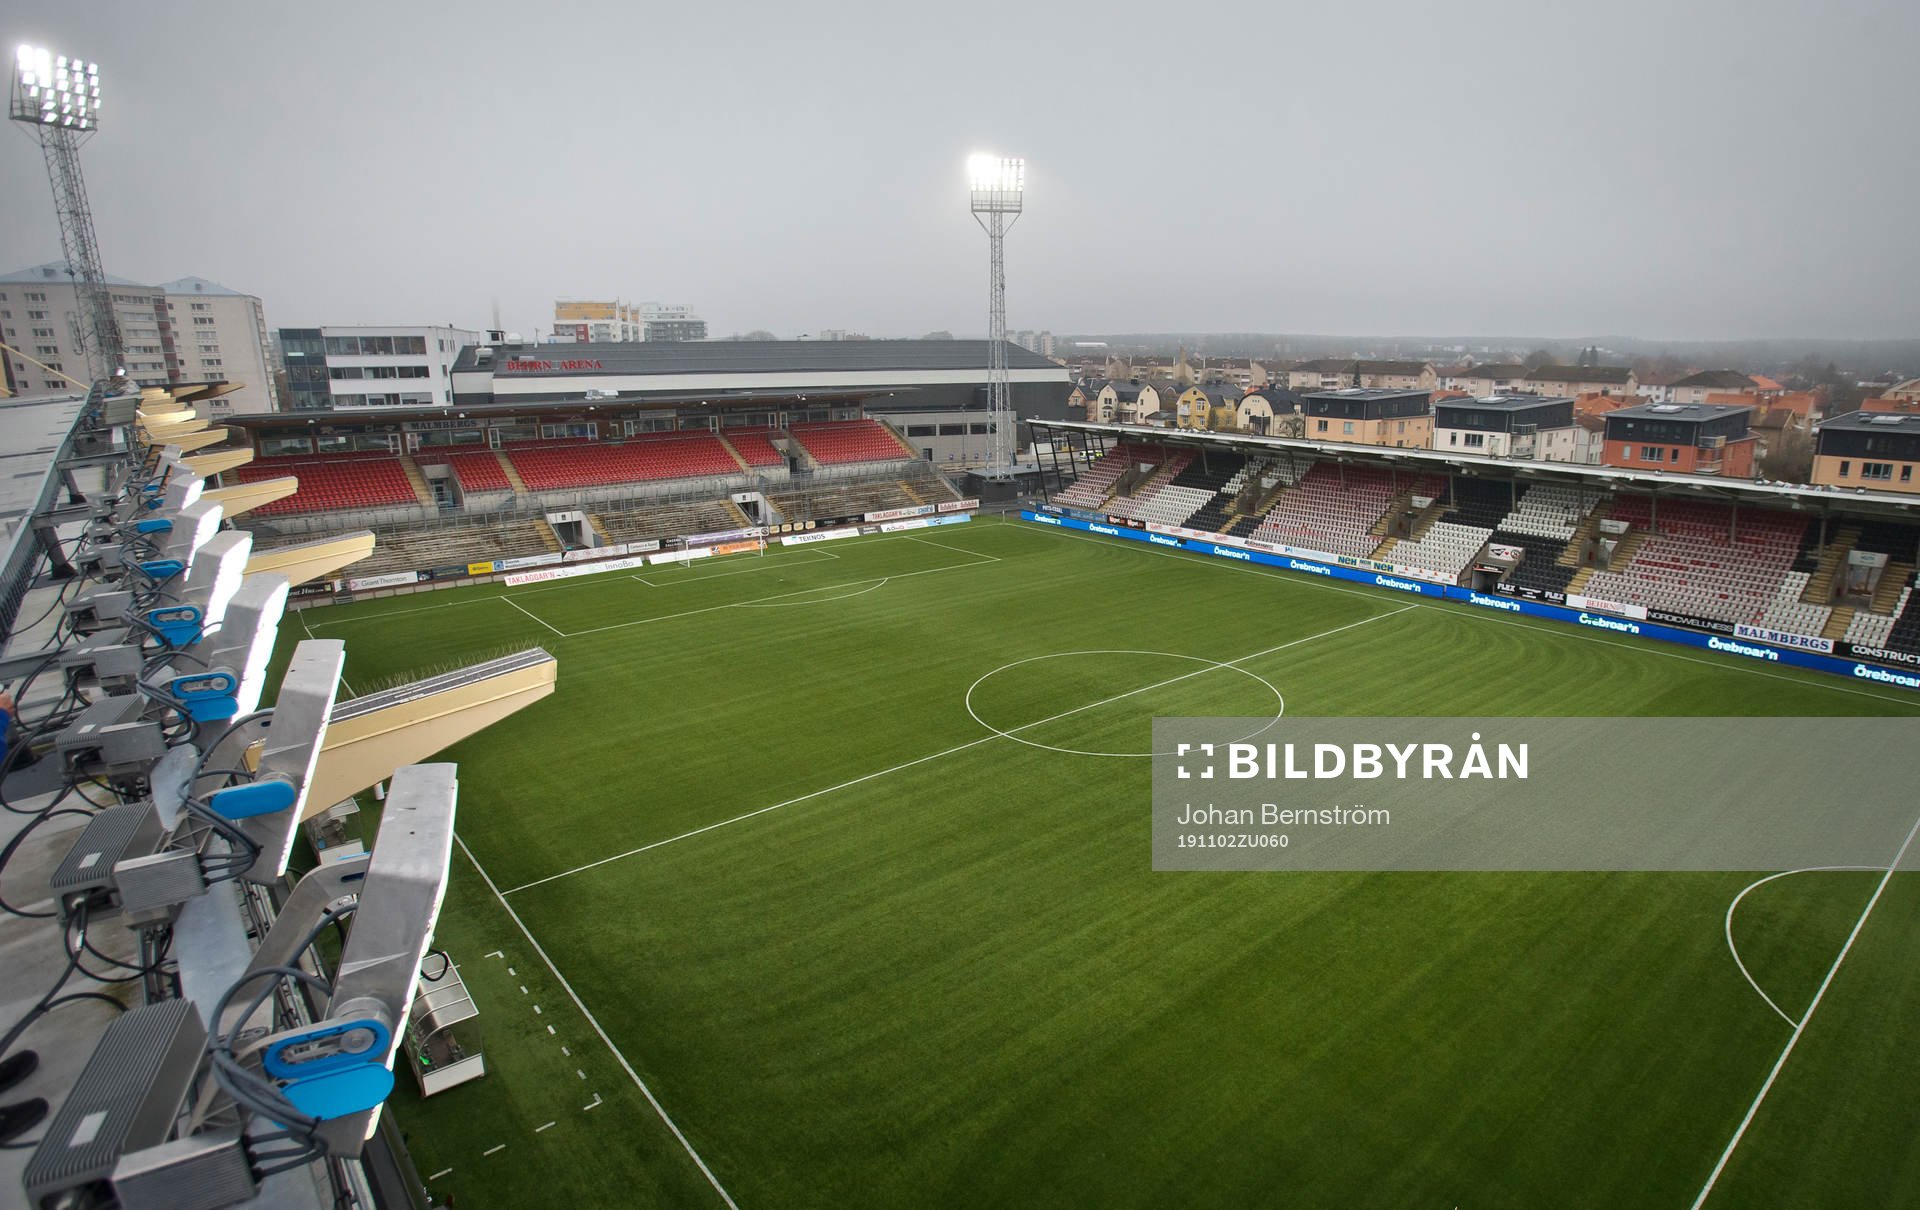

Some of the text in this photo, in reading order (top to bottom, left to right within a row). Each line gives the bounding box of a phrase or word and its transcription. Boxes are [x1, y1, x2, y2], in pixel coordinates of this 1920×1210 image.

[561, 360, 602, 369] ARENA
[798, 533, 826, 543] TEKNOS
[1213, 545, 1250, 560] Örebroar'n
[1290, 559, 1331, 576] Örebroar'n
[1375, 575, 1421, 593] Örebroar'n
[1497, 583, 1516, 592] FLEX
[1544, 591, 1565, 600] FLEX
[1586, 600, 1616, 611] BEHRN
[1738, 626, 1830, 651] MALMBERGS
[1708, 636, 1778, 660] Örebroar'n
